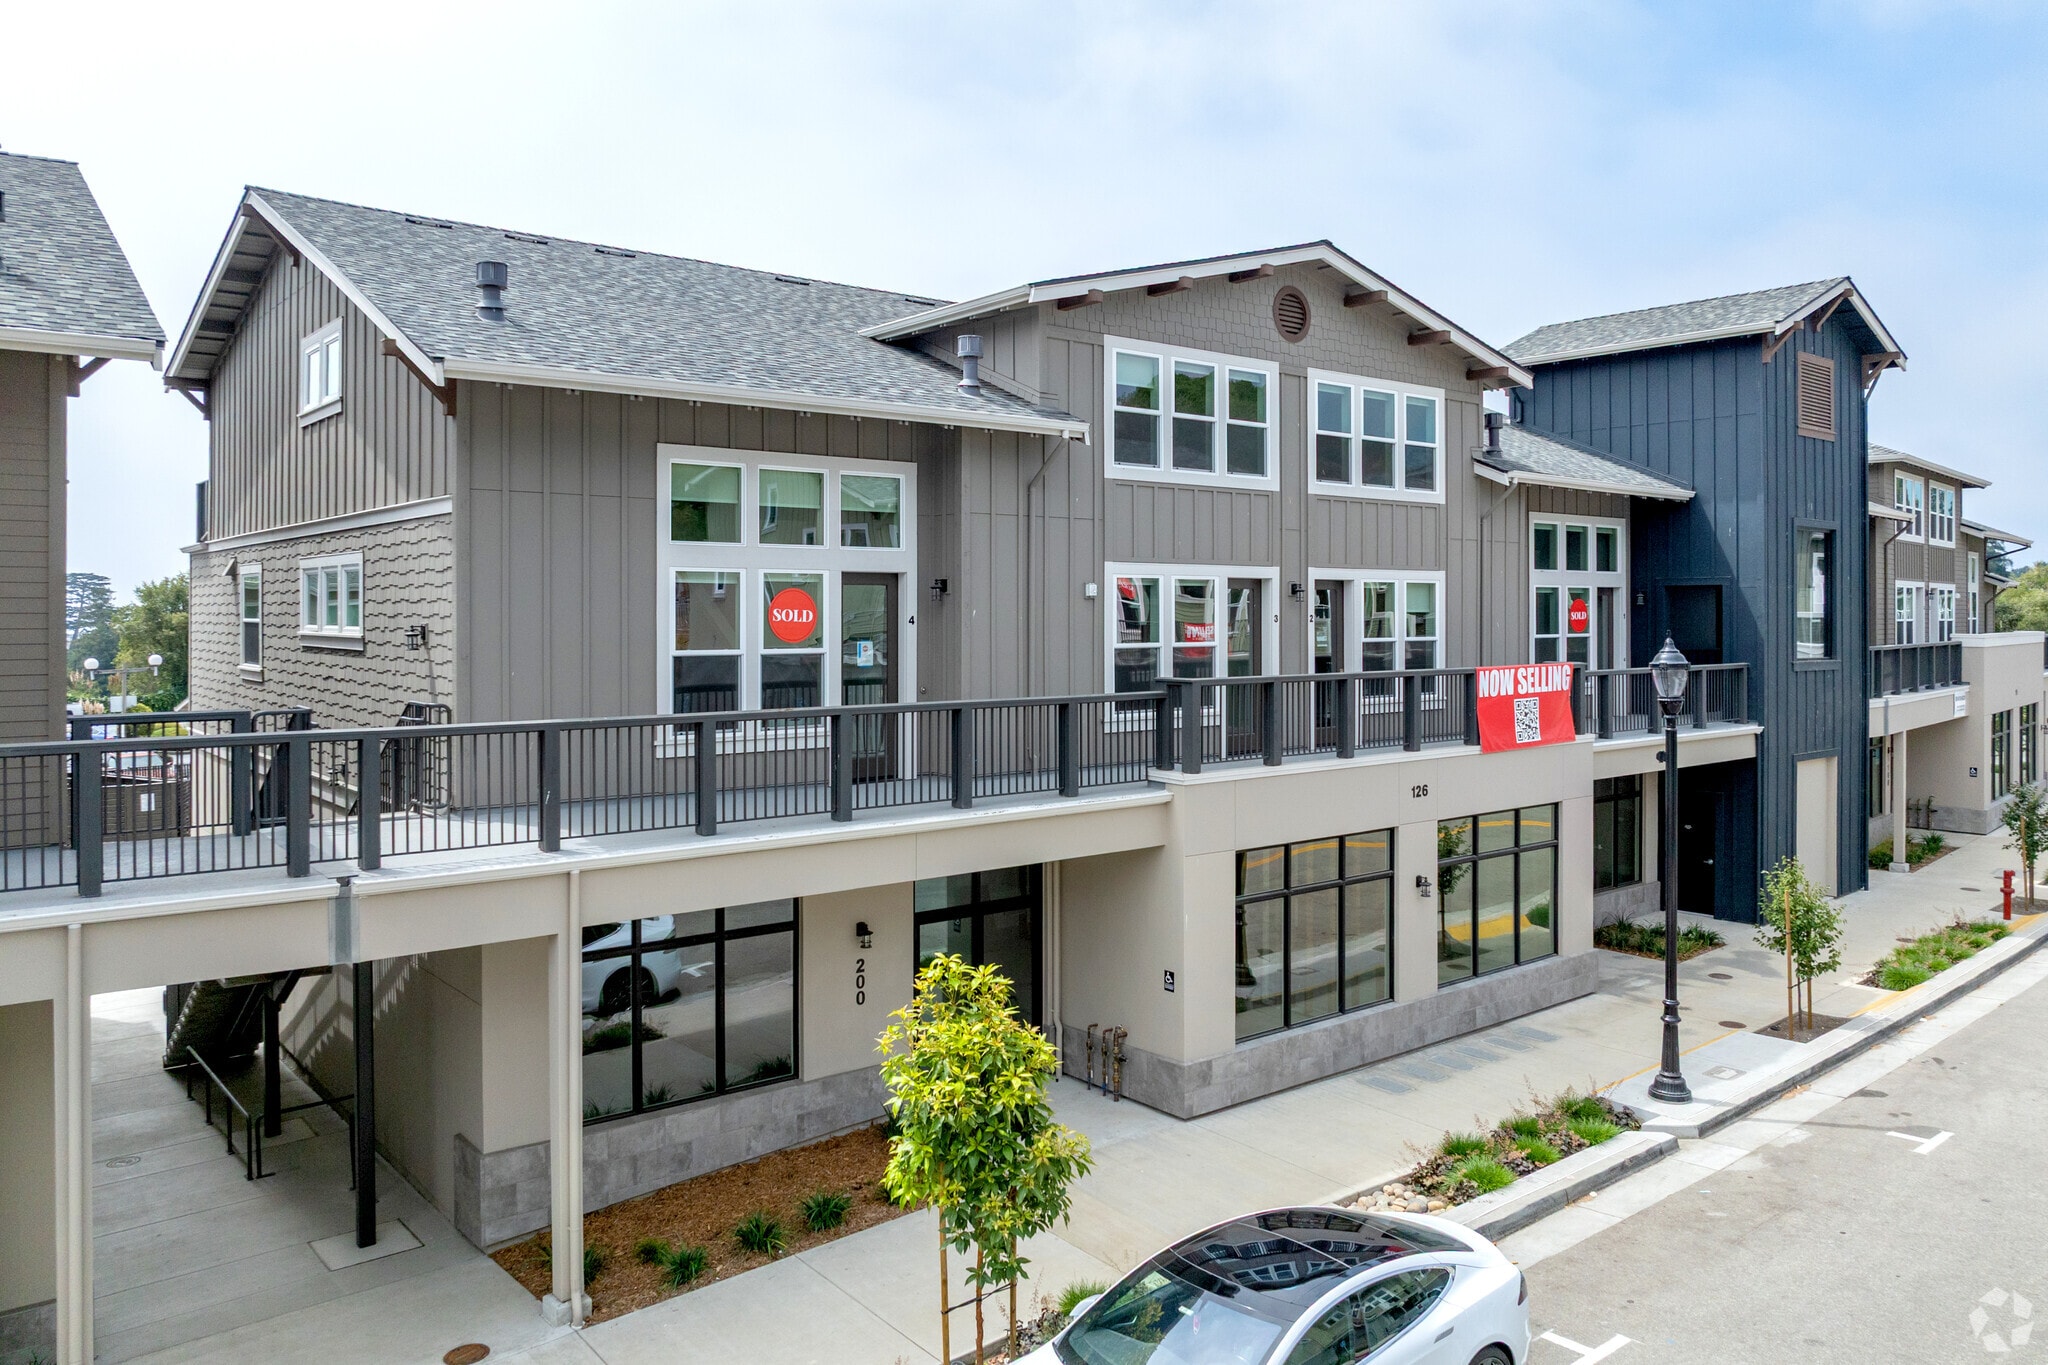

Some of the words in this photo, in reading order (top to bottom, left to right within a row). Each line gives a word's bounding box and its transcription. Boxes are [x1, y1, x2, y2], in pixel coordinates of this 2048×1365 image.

[772, 608, 814, 623] SOLD
[908, 616, 915, 625] 4
[1273, 614, 1279, 623] 3
[1309, 614, 1314, 622] 2
[1571, 611, 1587, 620] SOLD
[1479, 668, 1515, 698] NOW
[1517, 664, 1571, 695] SELLING
[1411, 784, 1429, 798] 126
[855, 958, 865, 1005] 200
